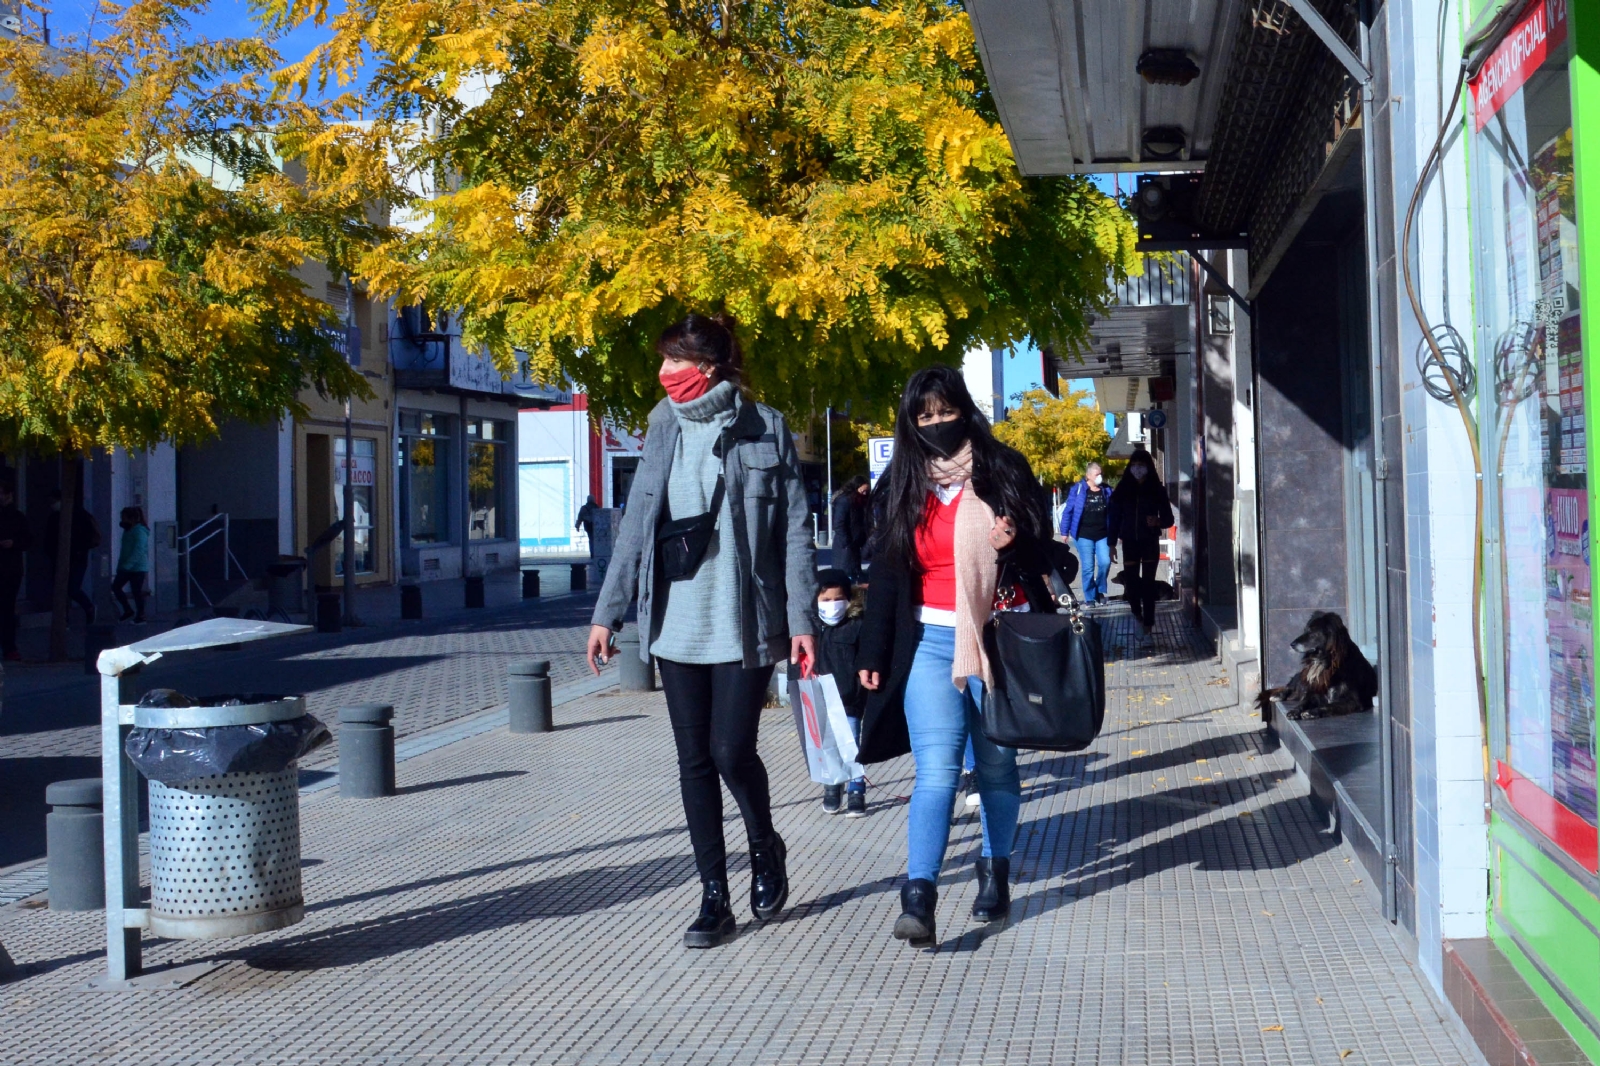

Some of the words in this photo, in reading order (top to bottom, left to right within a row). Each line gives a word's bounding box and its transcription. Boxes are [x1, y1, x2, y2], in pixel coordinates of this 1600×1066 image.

[1478, 50, 1511, 112] AGENCIA
[1511, 10, 1546, 72] OFICIAL
[880, 444, 890, 457] E
[1556, 495, 1579, 536] JUNIO
